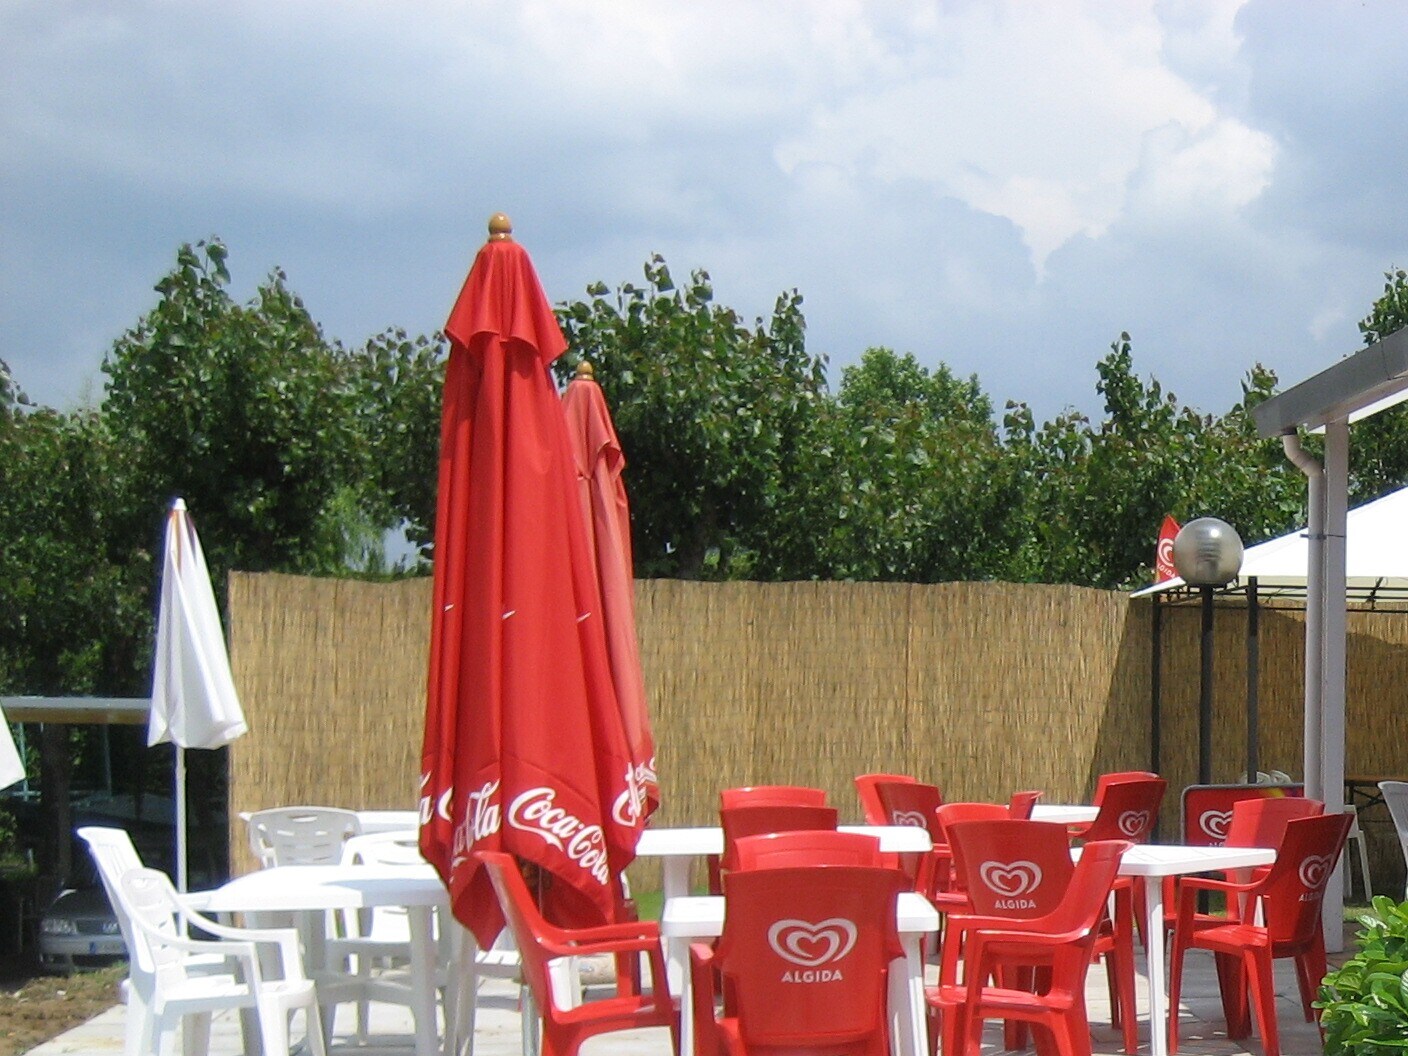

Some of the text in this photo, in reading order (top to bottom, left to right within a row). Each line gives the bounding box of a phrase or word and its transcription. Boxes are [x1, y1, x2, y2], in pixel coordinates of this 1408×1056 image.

[508, 786, 610, 886] Coca-Cola
[994, 899, 1037, 910] ALGIDA
[780, 968, 844, 984] ALGIDA
